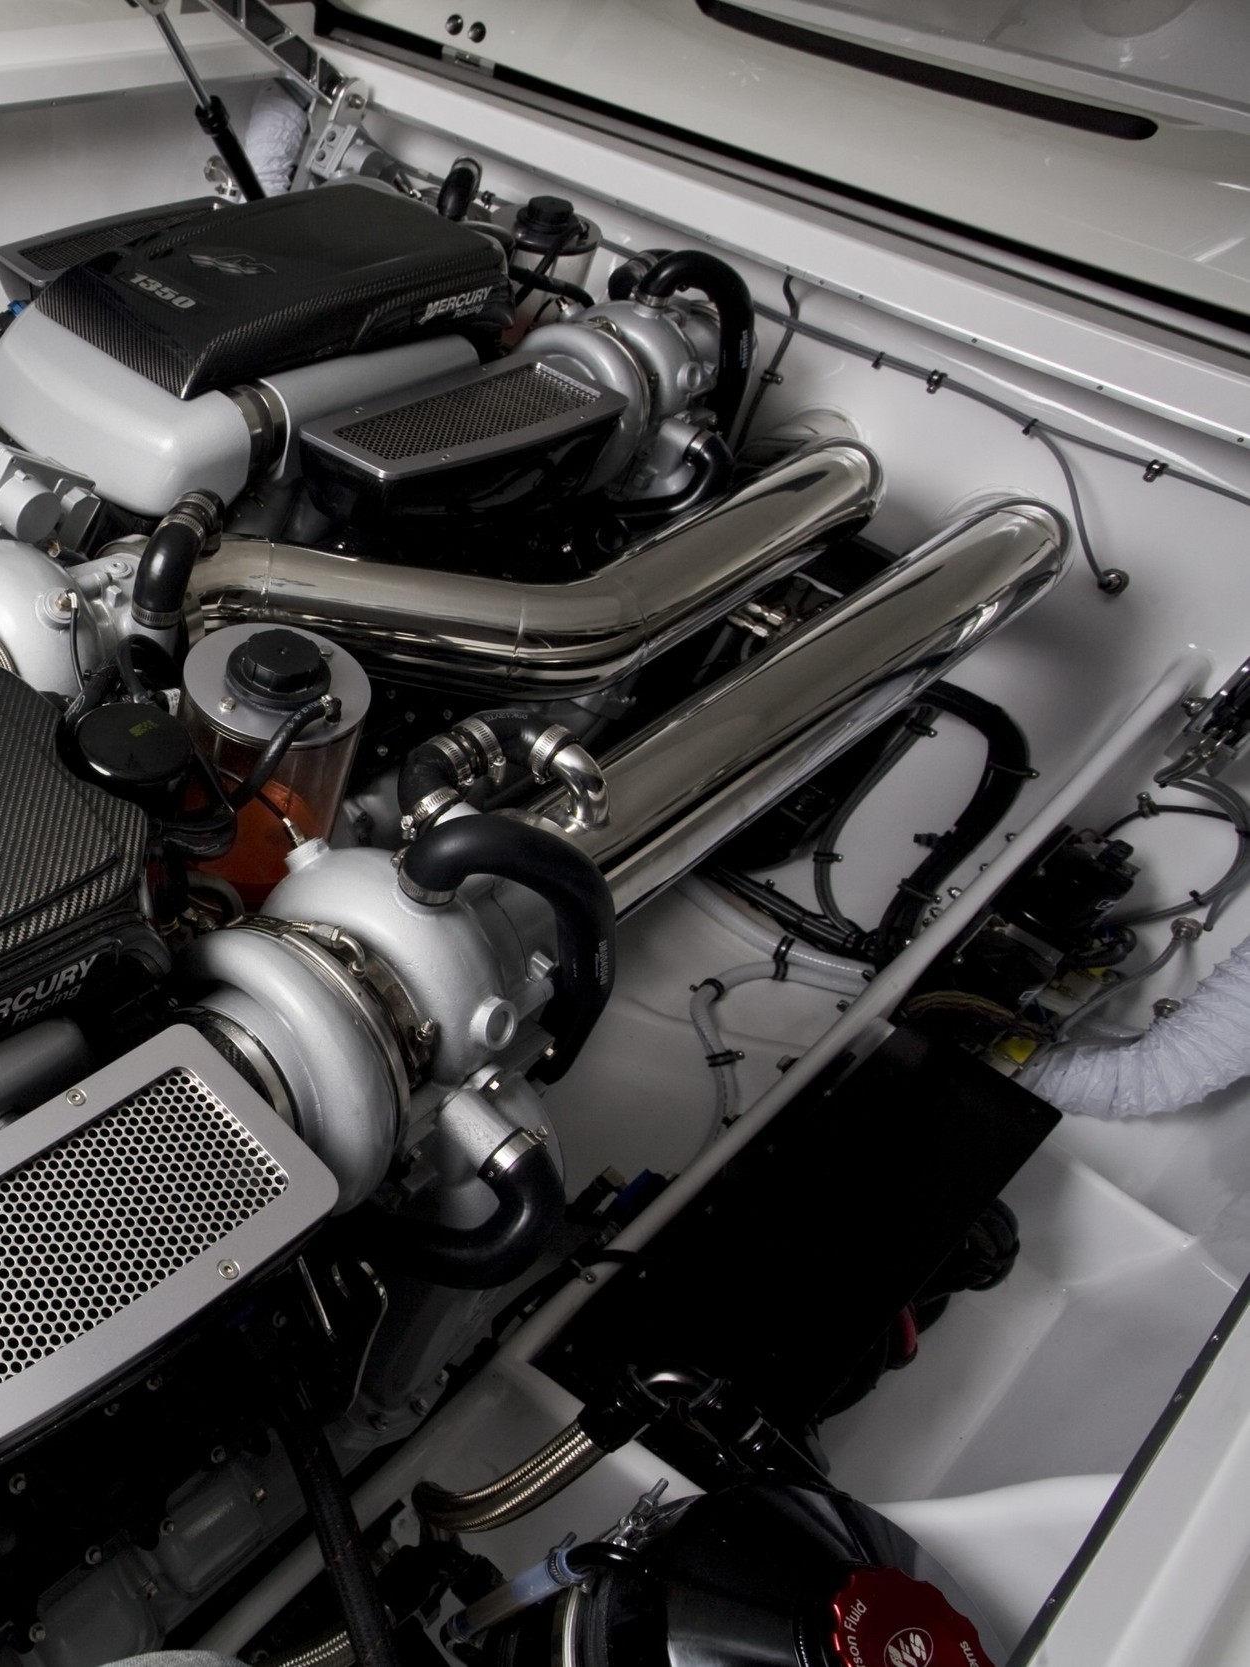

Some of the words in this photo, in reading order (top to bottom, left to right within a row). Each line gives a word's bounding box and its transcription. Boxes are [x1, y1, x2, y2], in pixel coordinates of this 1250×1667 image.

[129, 272, 196, 309] 1350
[418, 286, 493, 325] MERCURY
[453, 303, 484, 319] Racing
[11, 984, 82, 1027] Racing
[844, 1599, 868, 1633] Fluid
